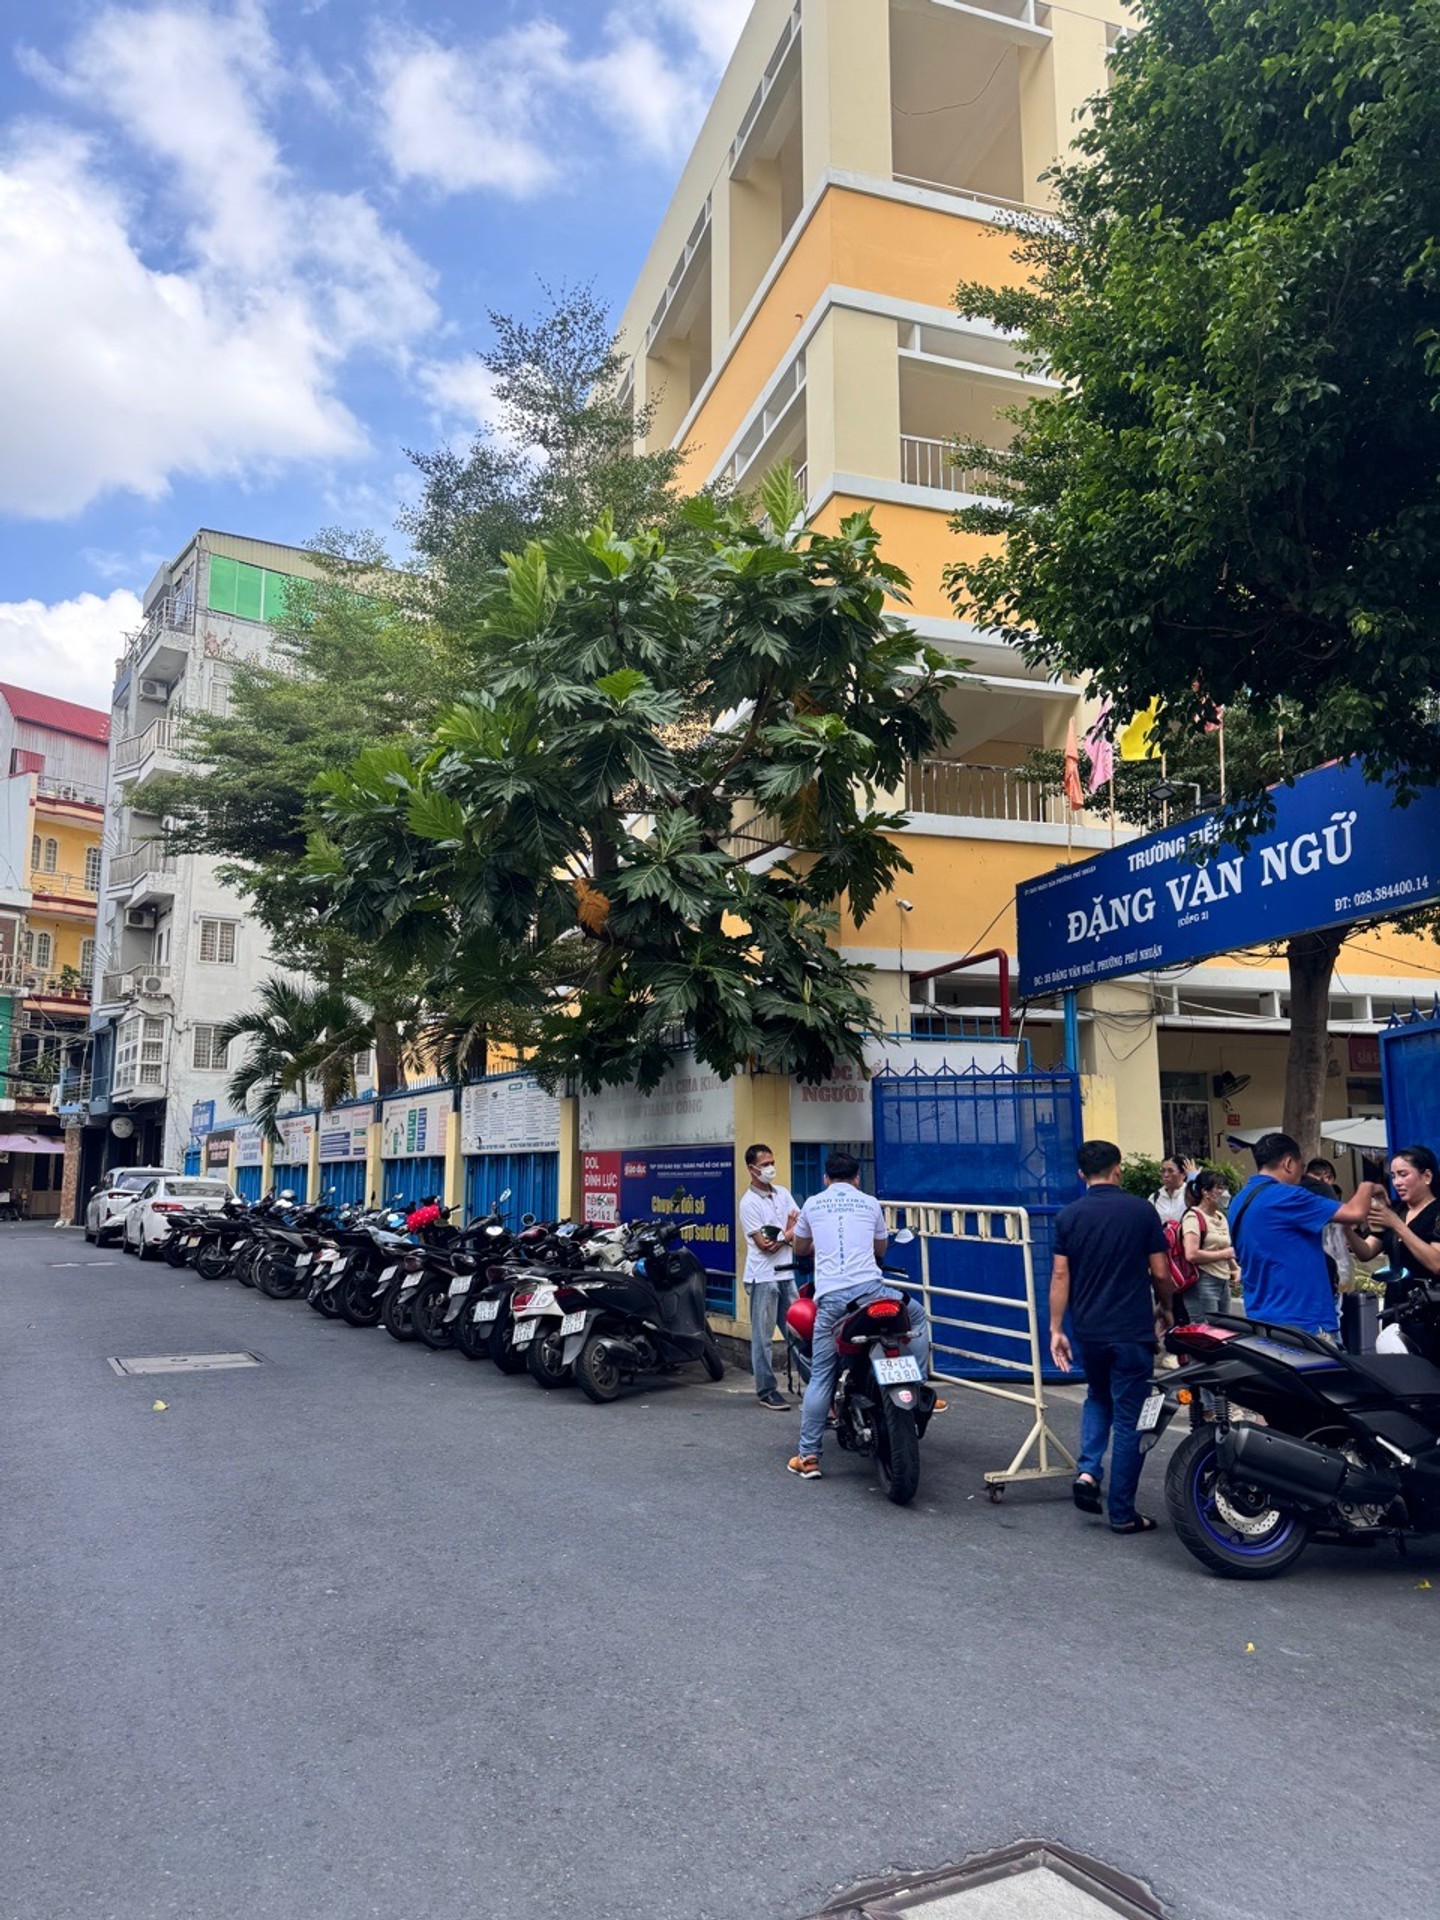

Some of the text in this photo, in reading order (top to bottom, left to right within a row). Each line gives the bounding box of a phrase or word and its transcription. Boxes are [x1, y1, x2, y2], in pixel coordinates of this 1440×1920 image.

[1128, 836, 1185, 872] TRƯỜNG
[1067, 887, 1156, 944] ĐẶNG
[1166, 856, 1244, 912] VĂN
[1260, 810, 1357, 886] NGỮ
[1335, 875, 1429, 911] ĐT: 028.384400.14
[1097, 956, 1122, 971] PHƯỜNG
[1125, 949, 1138, 965] PHÚ
[1139, 944, 1162, 961] NHUẬN
[802, 1084, 864, 1103] NGƯỜI
[585, 1156, 599, 1169] DOL
[585, 1170, 617, 1189] ĐÌNH LỰC
